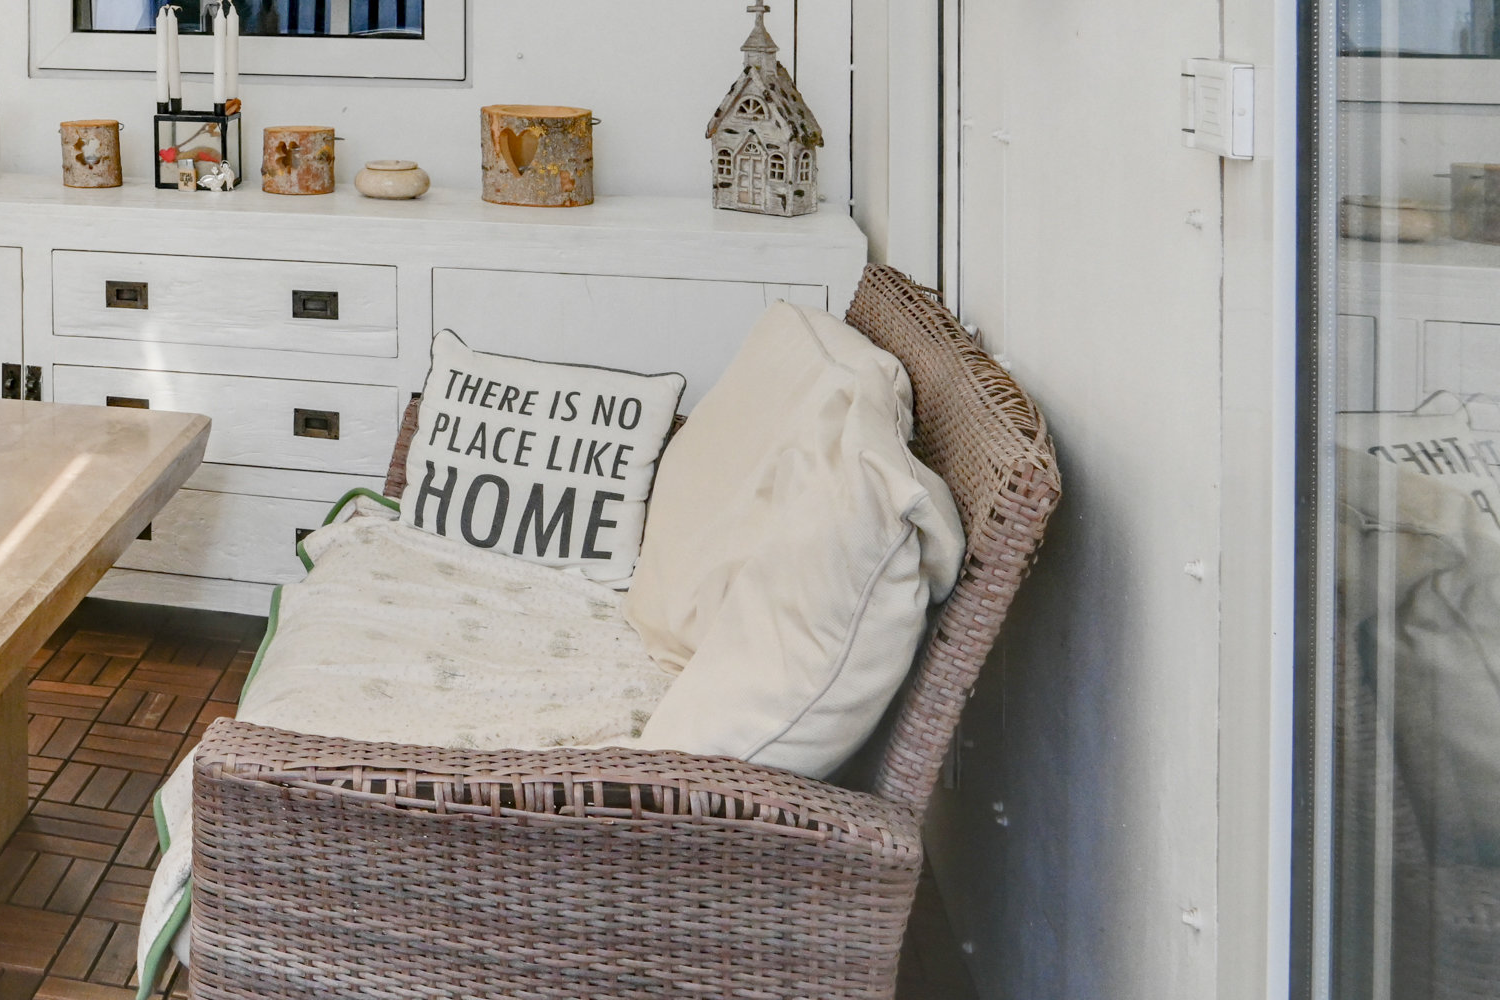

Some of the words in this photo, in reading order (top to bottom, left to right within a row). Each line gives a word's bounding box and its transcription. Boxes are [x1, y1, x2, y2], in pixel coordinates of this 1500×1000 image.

[445, 369, 539, 416] THERE
[548, 390, 581, 422] IS
[591, 394, 643, 431] NO
[428, 412, 537, 467] PLACE
[545, 435, 635, 481] LIKE
[413, 459, 625, 560] HOME
